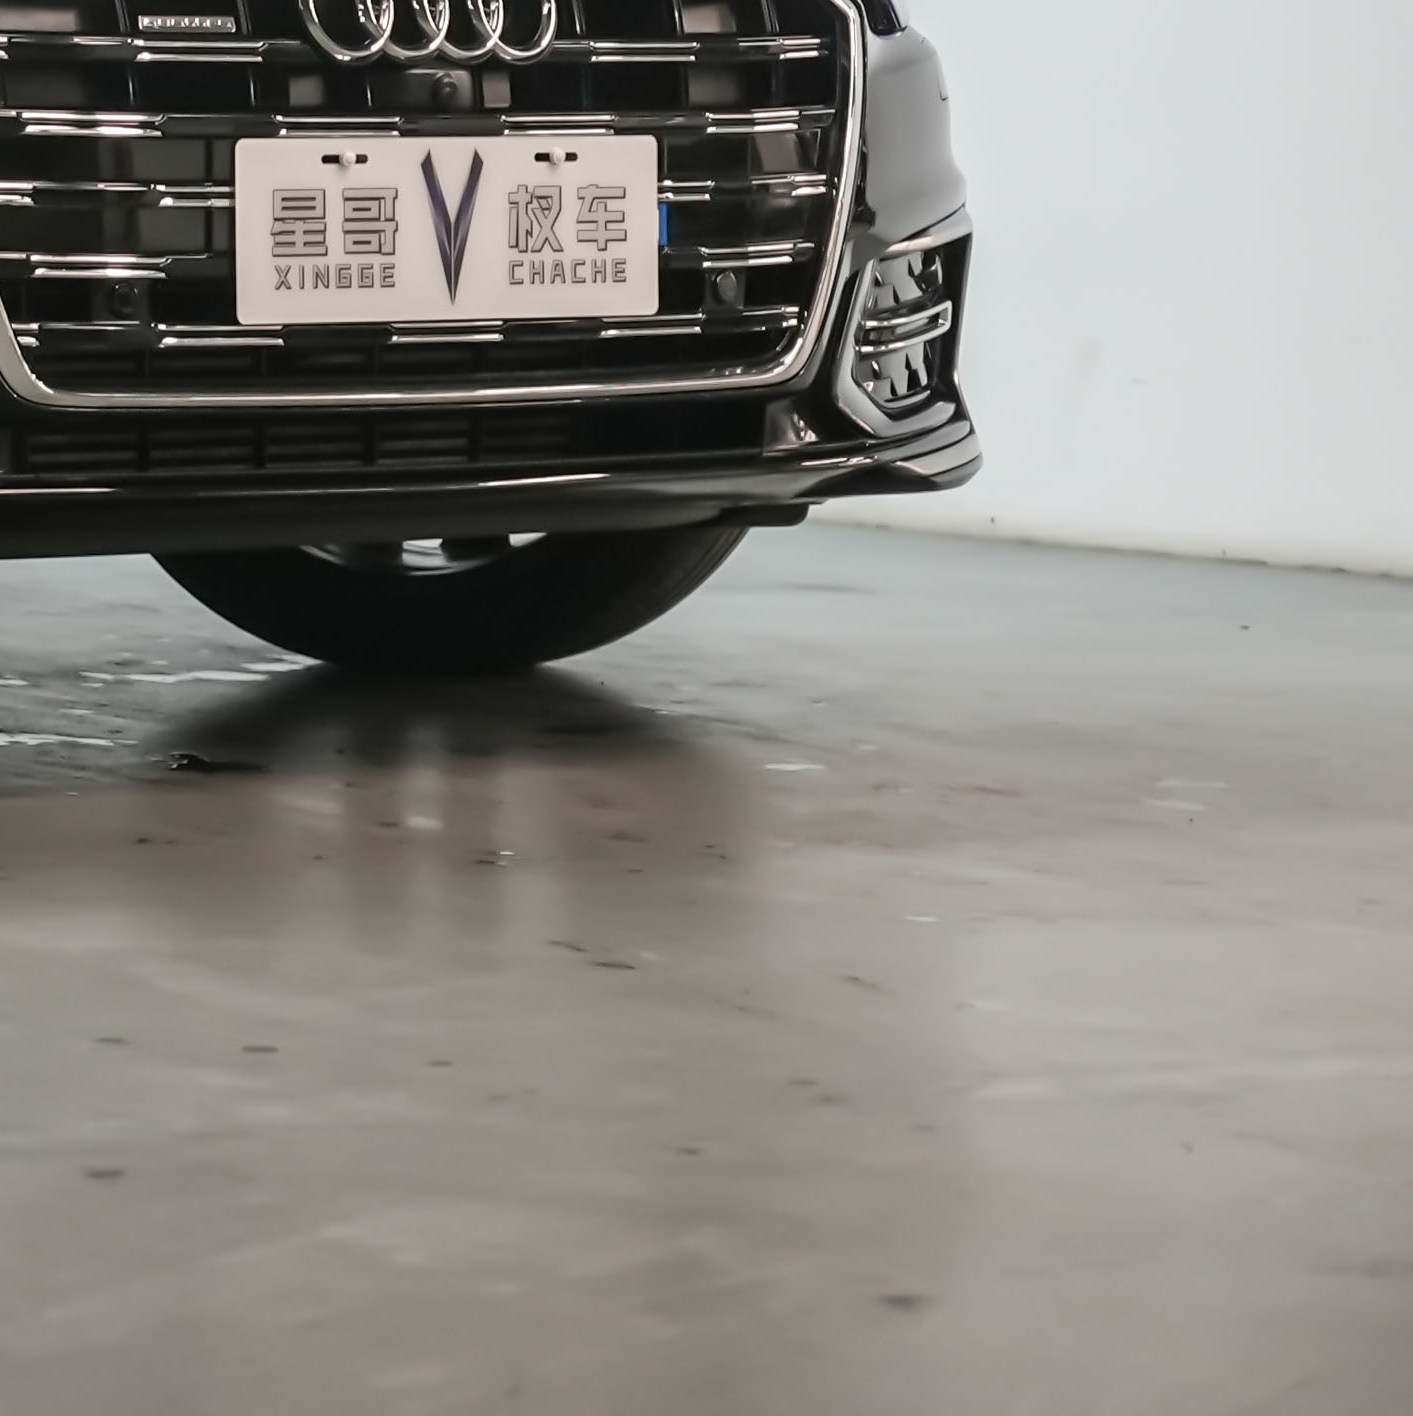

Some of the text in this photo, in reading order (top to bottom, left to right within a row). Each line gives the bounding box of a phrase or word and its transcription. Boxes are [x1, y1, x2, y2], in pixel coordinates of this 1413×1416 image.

[270, 187, 399, 257] 星哥
[274, 258, 627, 290] XINGGE CHACHE
